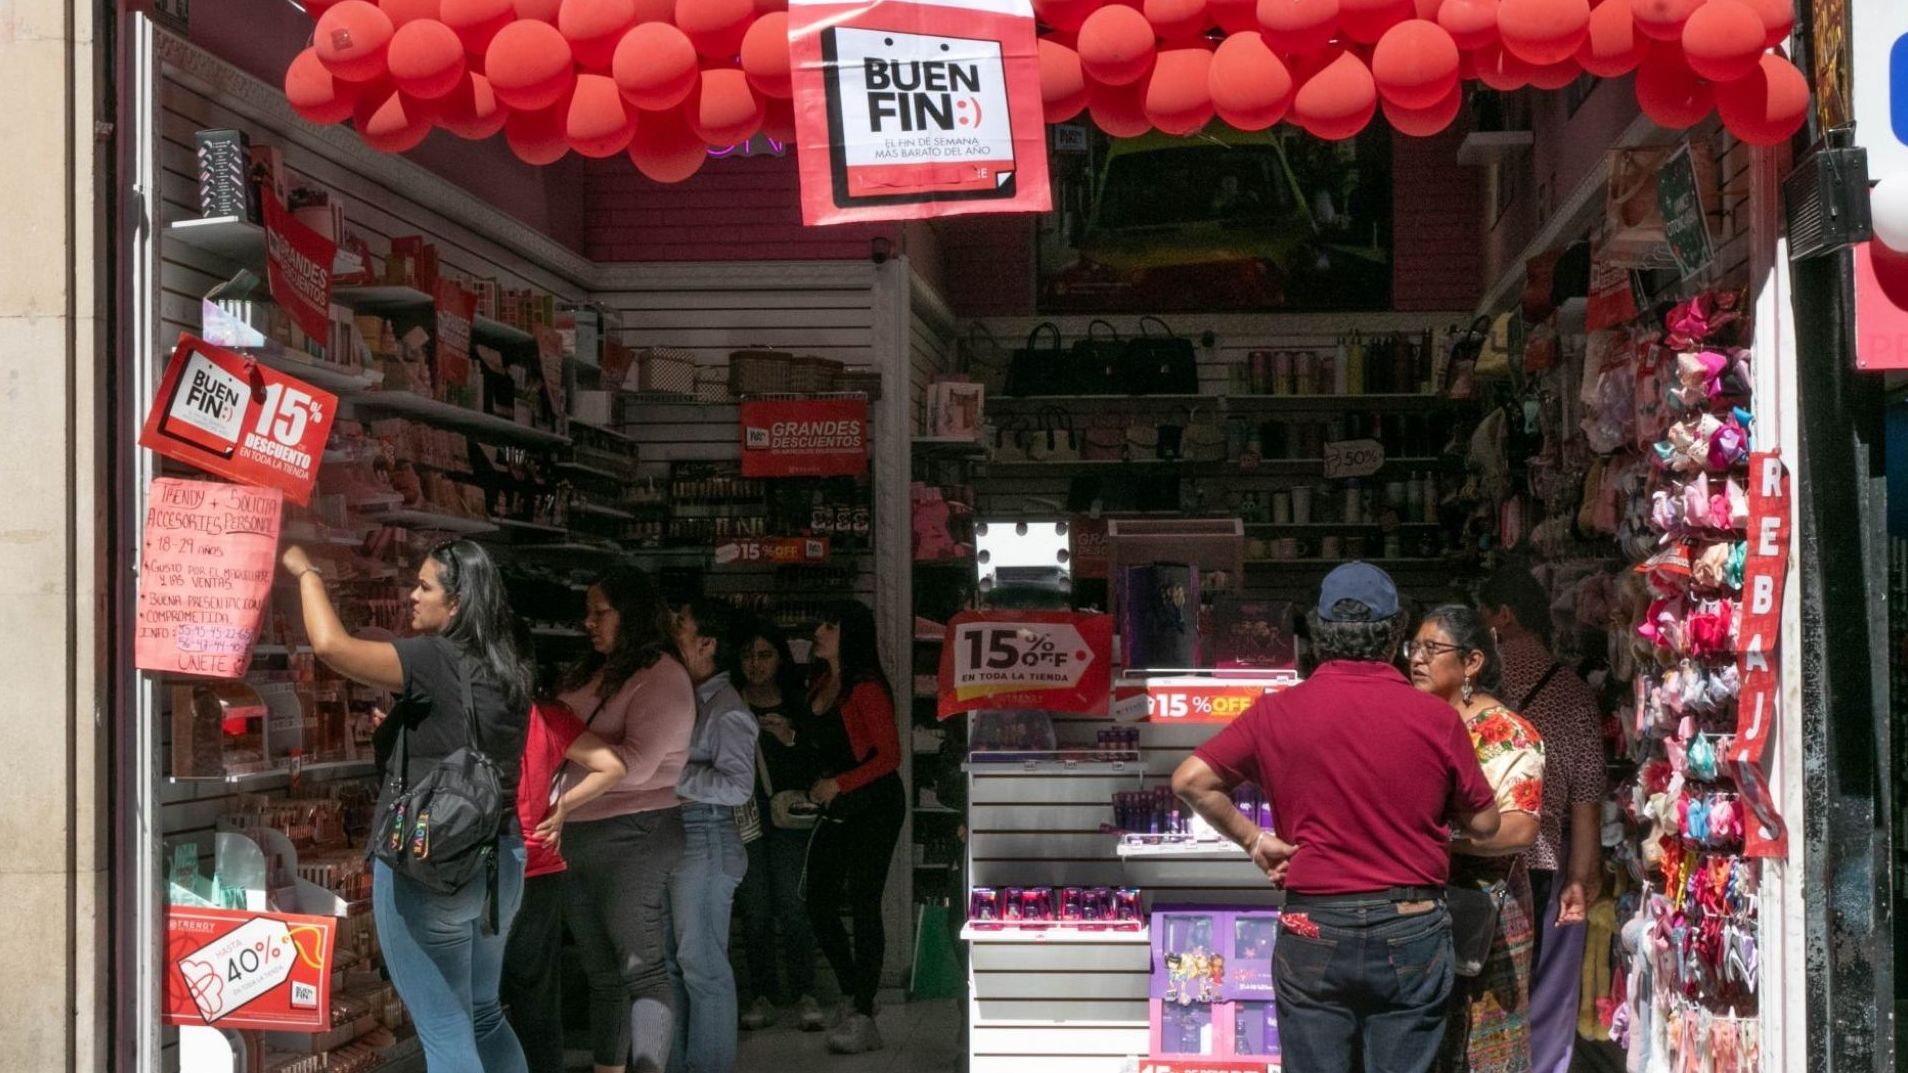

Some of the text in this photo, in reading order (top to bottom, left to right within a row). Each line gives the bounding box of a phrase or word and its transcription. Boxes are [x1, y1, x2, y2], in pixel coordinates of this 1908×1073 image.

[864, 57, 980, 92] BUEN
[899, 138, 915, 146] FIN
[919, 137, 930, 146] DE
[934, 137, 979, 146] SEMANA
[901, 147, 941, 158] BARATO
[944, 147, 962, 156] DEL
[193, 369, 240, 407] BUEN
[771, 420, 861, 437] GRANDES
[771, 436, 862, 449] DESCUENTOS
[244, 433, 312, 469] DESCUENTO
[1344, 449, 1378, 466] 50%
[240, 448, 309, 481] EN TODA LA TIENDA
[157, 535, 194, 555] 18-29
[740, 543, 760, 559] 15
[775, 545, 798, 556] OFF
[151, 559, 182, 574] GUSTO
[191, 577, 233, 590] VENTAS
[150, 592, 182, 606] BUENA
[962, 672, 1069, 682] EN TODA LA TIENDA
[1155, 693, 1188, 718] 15
[1211, 697, 1252, 714] OFF
[178, 919, 216, 930] TRENDY
